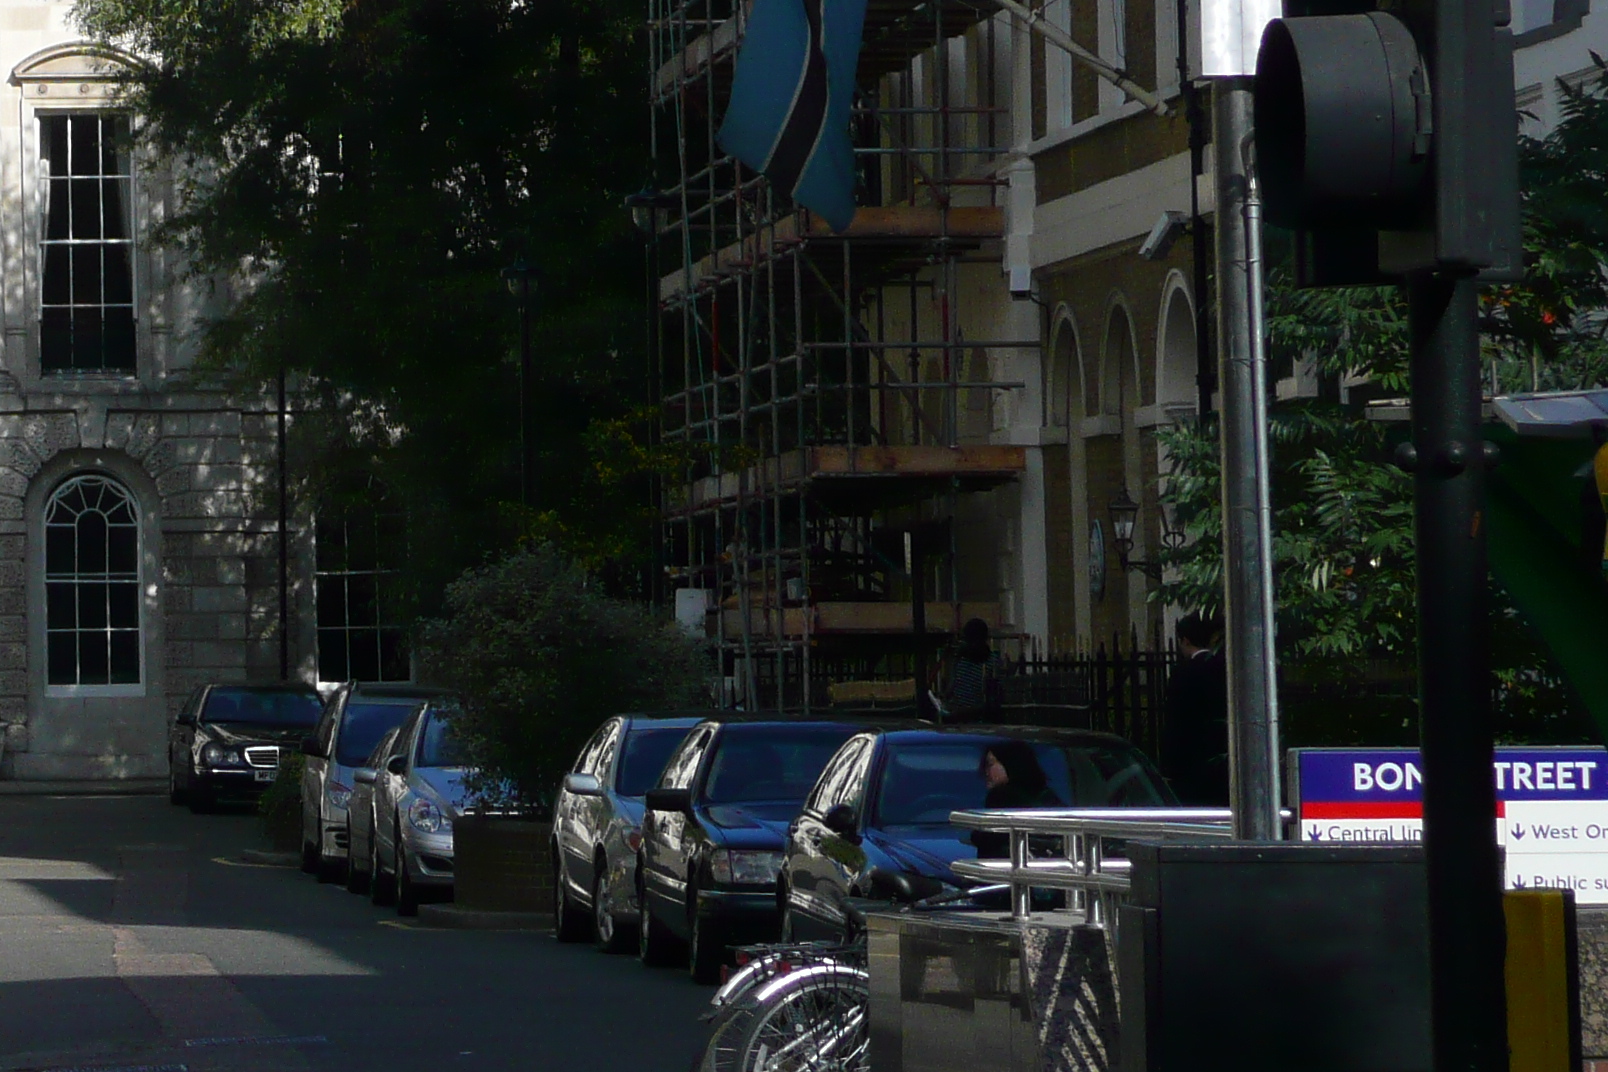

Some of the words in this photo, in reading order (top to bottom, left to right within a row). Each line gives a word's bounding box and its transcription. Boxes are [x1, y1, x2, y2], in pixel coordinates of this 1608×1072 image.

[1353, 762, 1422, 792] BON
[1493, 761, 1597, 790] TREET
[1328, 825, 1395, 841] Central
[1402, 825, 1422, 841] lin
[1531, 823, 1579, 839] West
[1534, 875, 1587, 890] Public
